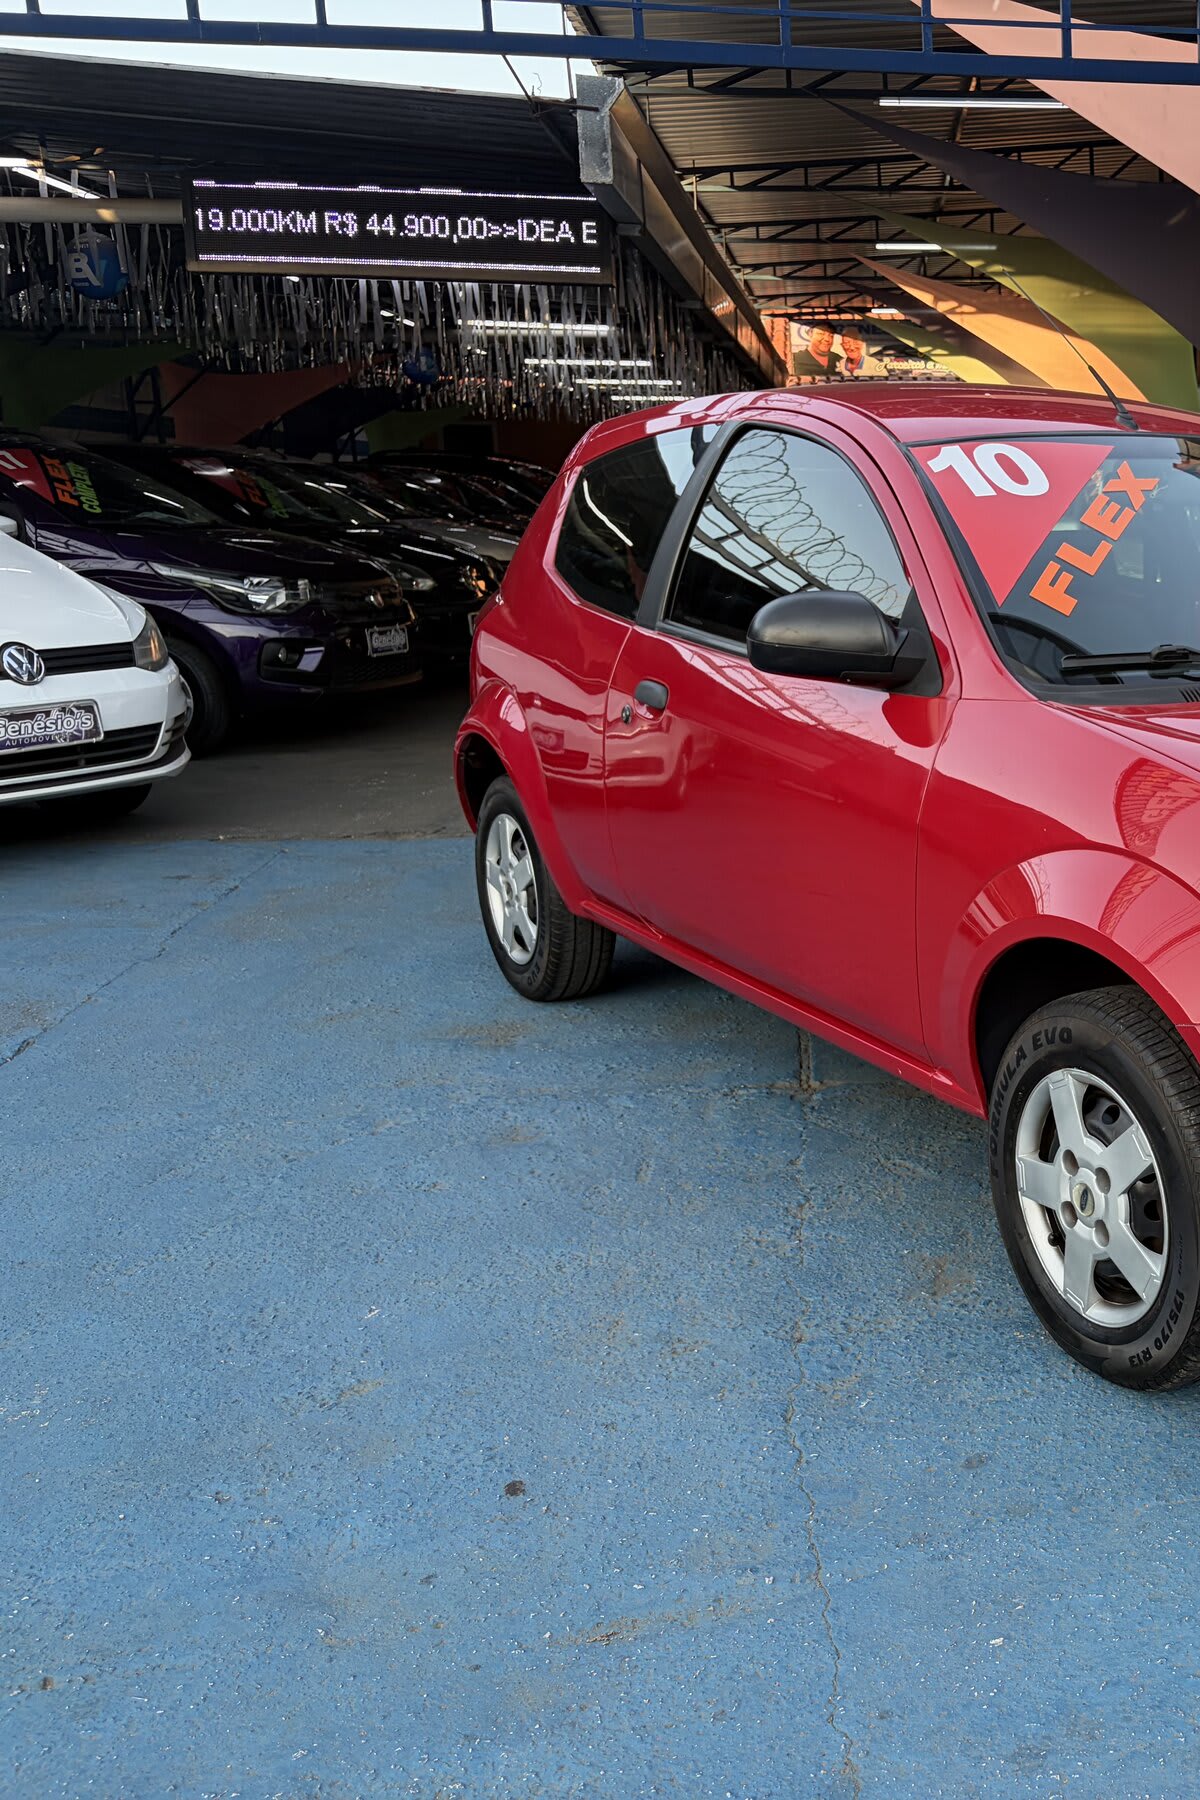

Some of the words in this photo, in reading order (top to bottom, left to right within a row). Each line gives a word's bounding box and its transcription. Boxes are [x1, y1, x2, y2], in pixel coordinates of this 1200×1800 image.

[195, 208, 317, 233] 19.000KM
[324, 211, 358, 237] R$
[582, 221, 597, 244] E
[927, 443, 1050, 497] 10
[1029, 460, 1160, 617] FLEX
